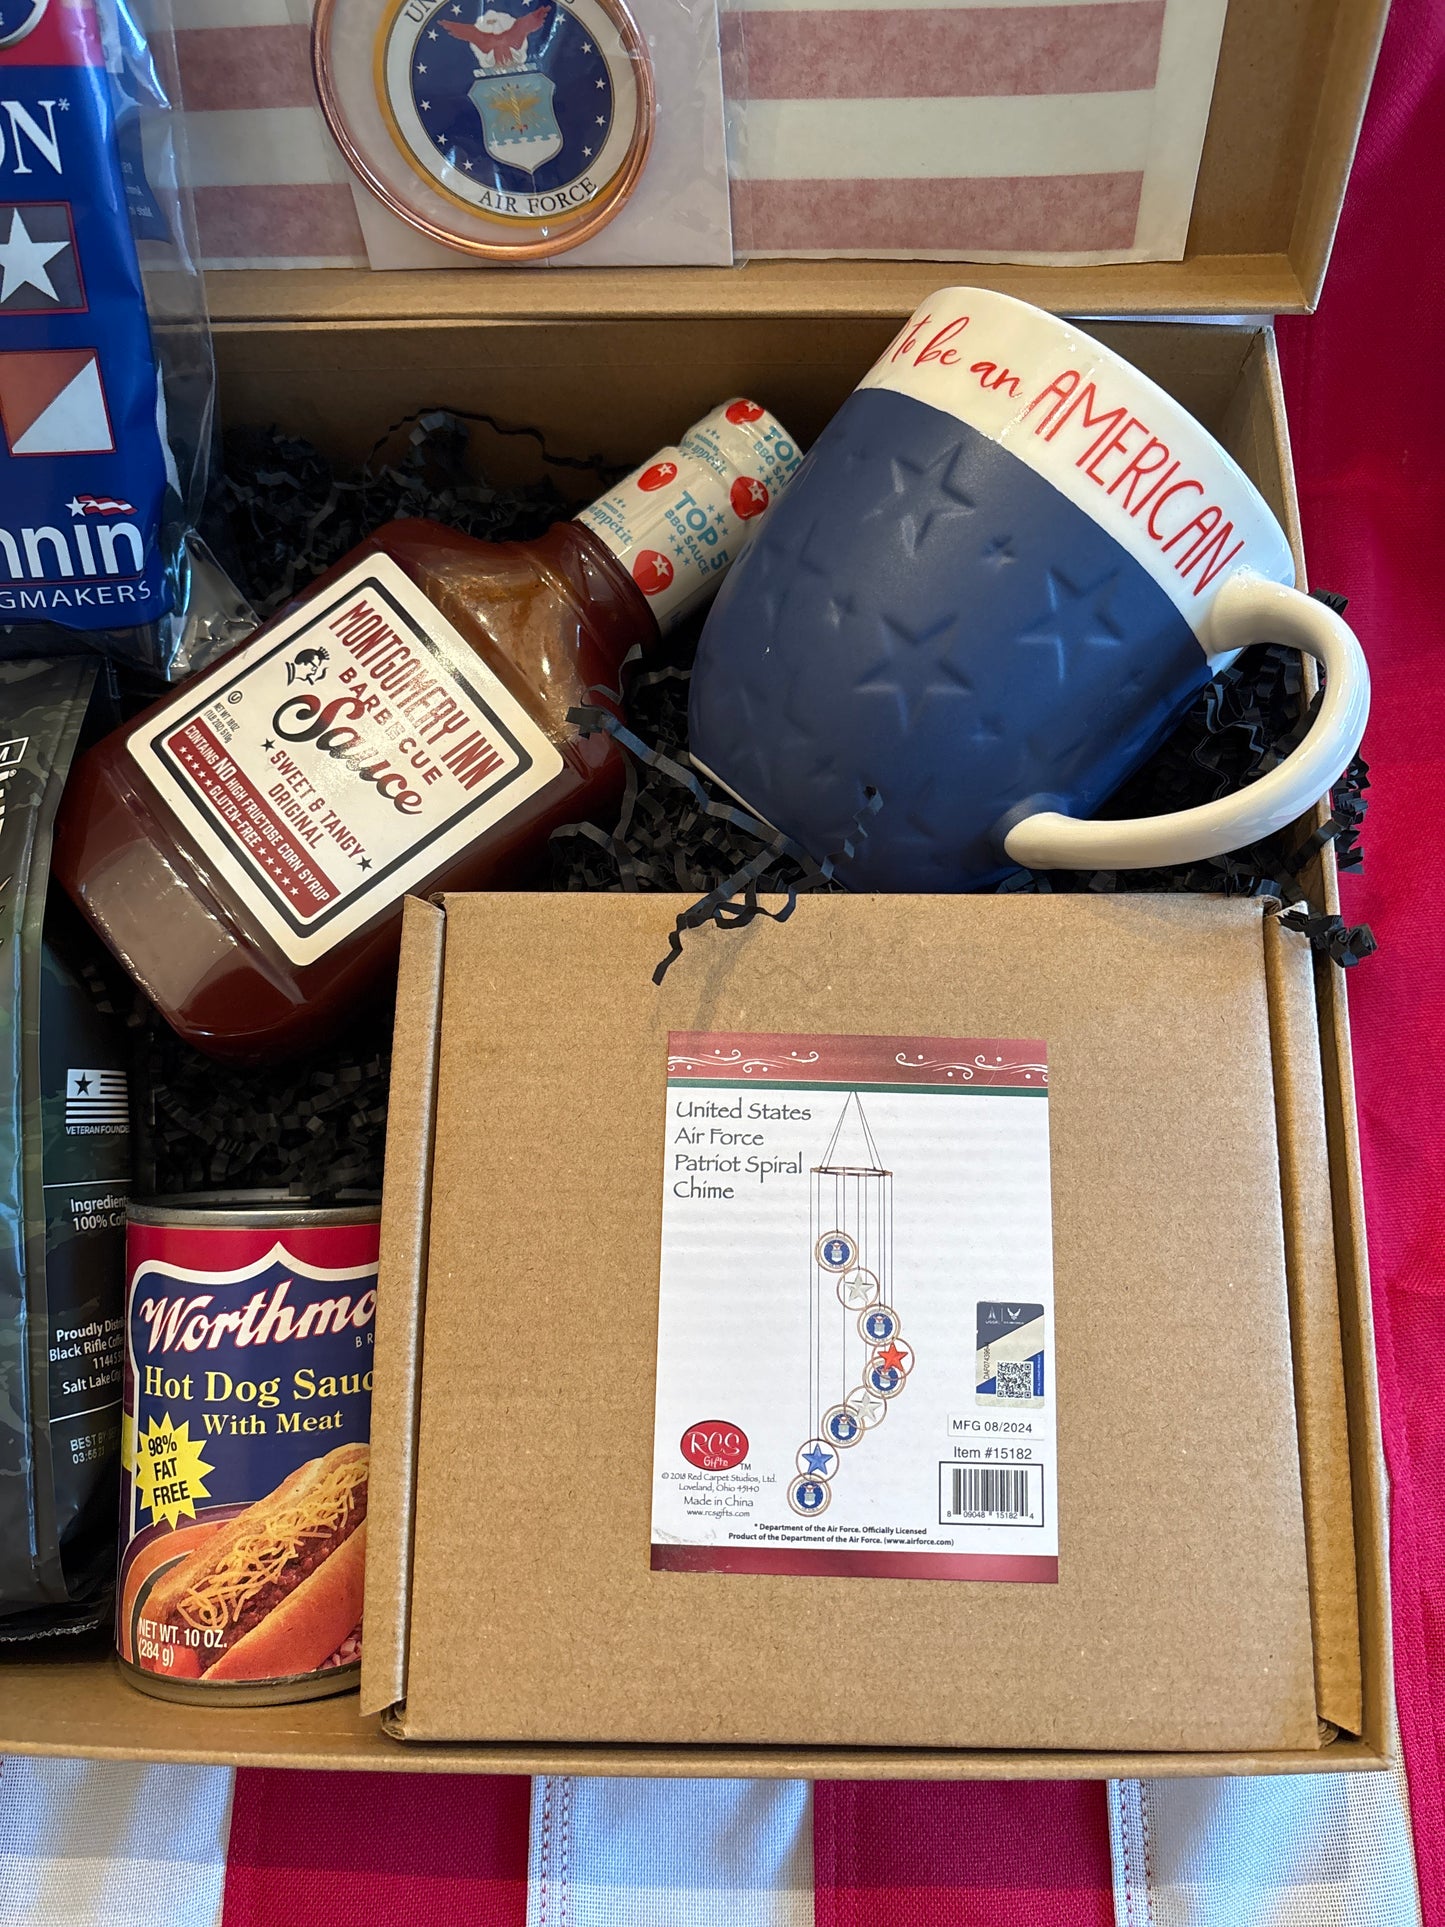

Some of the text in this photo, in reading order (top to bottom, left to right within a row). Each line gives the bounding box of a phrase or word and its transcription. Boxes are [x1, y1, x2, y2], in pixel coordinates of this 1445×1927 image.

[478, 177, 597, 213] AIR FORCE
[753, 441, 775, 465] BBQ
[891, 314, 931, 362] to
[913, 316, 970, 367] be
[970, 362, 1023, 398] an
[1018, 369, 1244, 596] AMERICAN
[664, 509, 710, 575] BBQ SAUCE
[675, 490, 718, 546] TOP
[710, 550, 729, 570] 5
[0, 580, 151, 609] GMAKERS
[329, 600, 504, 791] MONTGOMERY INN
[338, 667, 443, 785] BARBECUE
[273, 695, 422, 814] Sauce
[184, 725, 330, 902] CONTAINS NO HIGH FRUCTOSE CORN SYRUP
[209, 785, 262, 848] GLUTEN-FREE
[268, 783, 325, 849] ORIGINAL
[270, 750, 366, 863] SWEET & TANGY
[676, 1097, 812, 1120] United States
[66, 1125, 100, 1135] VETERAN
[674, 1127, 764, 1145] Air Force
[675, 1151, 802, 1183] Patriot Spiral
[673, 1175, 735, 1199] Chime
[73, 1214, 108, 1231] 100%
[139, 1278, 377, 1353] Worthmo
[57, 1322, 102, 1342] Proudly
[49, 1344, 82, 1361] Black
[84, 1339, 107, 1354] Rifle
[62, 1378, 87, 1395] Salt
[89, 1373, 110, 1389] Lake
[145, 1365, 194, 1400] Hot
[205, 1371, 281, 1408] Dog
[202, 1410, 343, 1435] With Meat
[952, 1420, 1032, 1433] MFG 08/2024
[70, 1434, 96, 1451] BEST
[148, 1433, 177, 1457] 98%
[687, 1431, 740, 1456] RCS
[954, 1446, 1032, 1459] Item #15182
[154, 1457, 177, 1481] FAT
[688, 1472, 702, 1481] Red
[703, 1473, 729, 1484] Carpet
[731, 1474, 761, 1483] Studios,
[762, 1474, 776, 1483] Ltd.
[153, 1480, 190, 1506] FREE
[679, 1483, 759, 1493] Loveland, Ohio 45140
[684, 1494, 754, 1507] Made in China
[687, 1507, 750, 1519] www.rcsgifts.com
[759, 1523, 803, 1532] Department
[862, 1526, 894, 1535] Officially
[896, 1527, 927, 1535] Licensed
[781, 1534, 825, 1543] Department
[883, 1536, 954, 1546] (www.airforce.com)
[139, 1617, 227, 1648] NET WT. 10 OZ.
[138, 1638, 174, 1667] (284 g)
